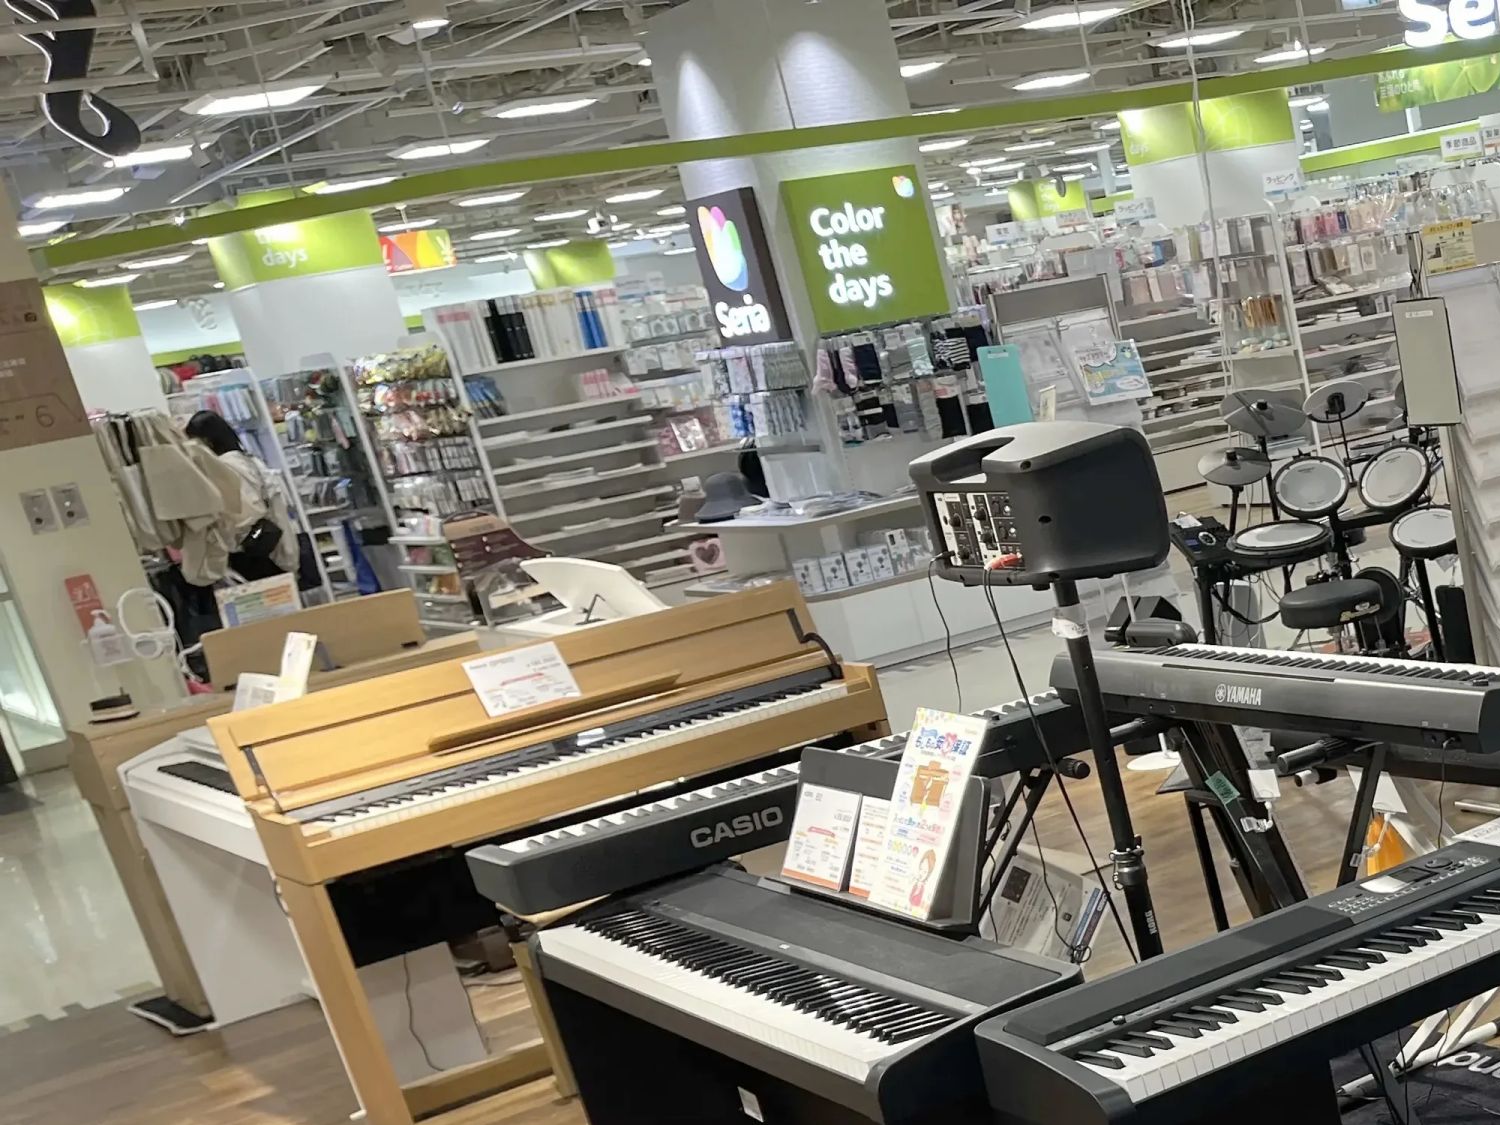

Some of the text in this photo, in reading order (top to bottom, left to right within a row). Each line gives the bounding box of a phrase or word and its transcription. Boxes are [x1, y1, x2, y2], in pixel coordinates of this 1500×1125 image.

[809, 201, 886, 238] Color
[262, 247, 309, 268] days
[818, 239, 868, 271] the
[828, 273, 894, 309] days
[715, 294, 771, 338] Seria
[1227, 685, 1261, 705] YAMAHA
[690, 806, 783, 848] CASIO
